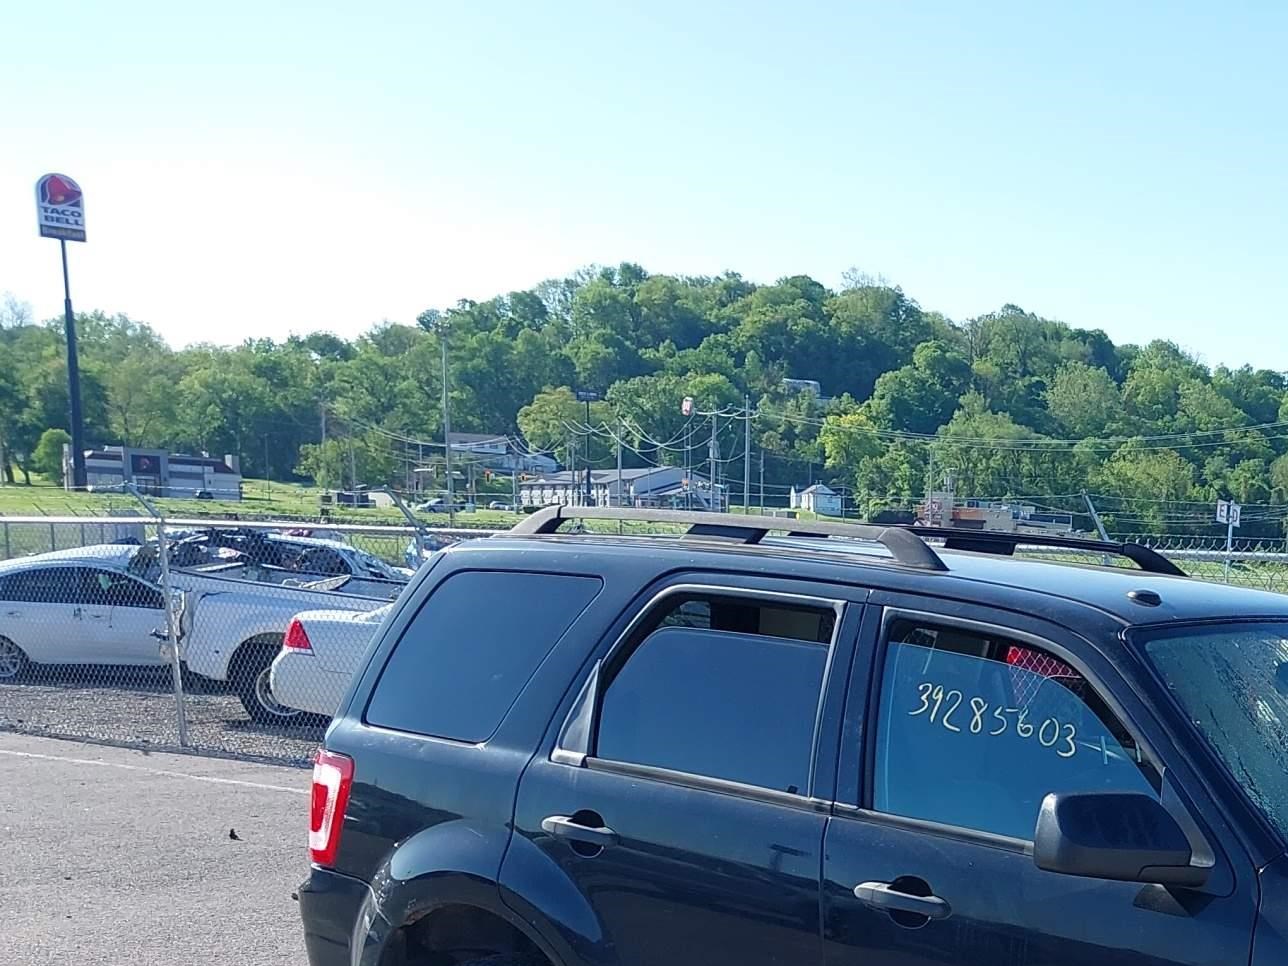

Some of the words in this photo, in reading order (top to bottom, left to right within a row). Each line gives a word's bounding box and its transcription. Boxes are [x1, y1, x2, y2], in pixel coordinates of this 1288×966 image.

[40, 206, 82, 218] TACO
[44, 215, 84, 226] BELL
[908, 682, 1077, 758] 39285603
